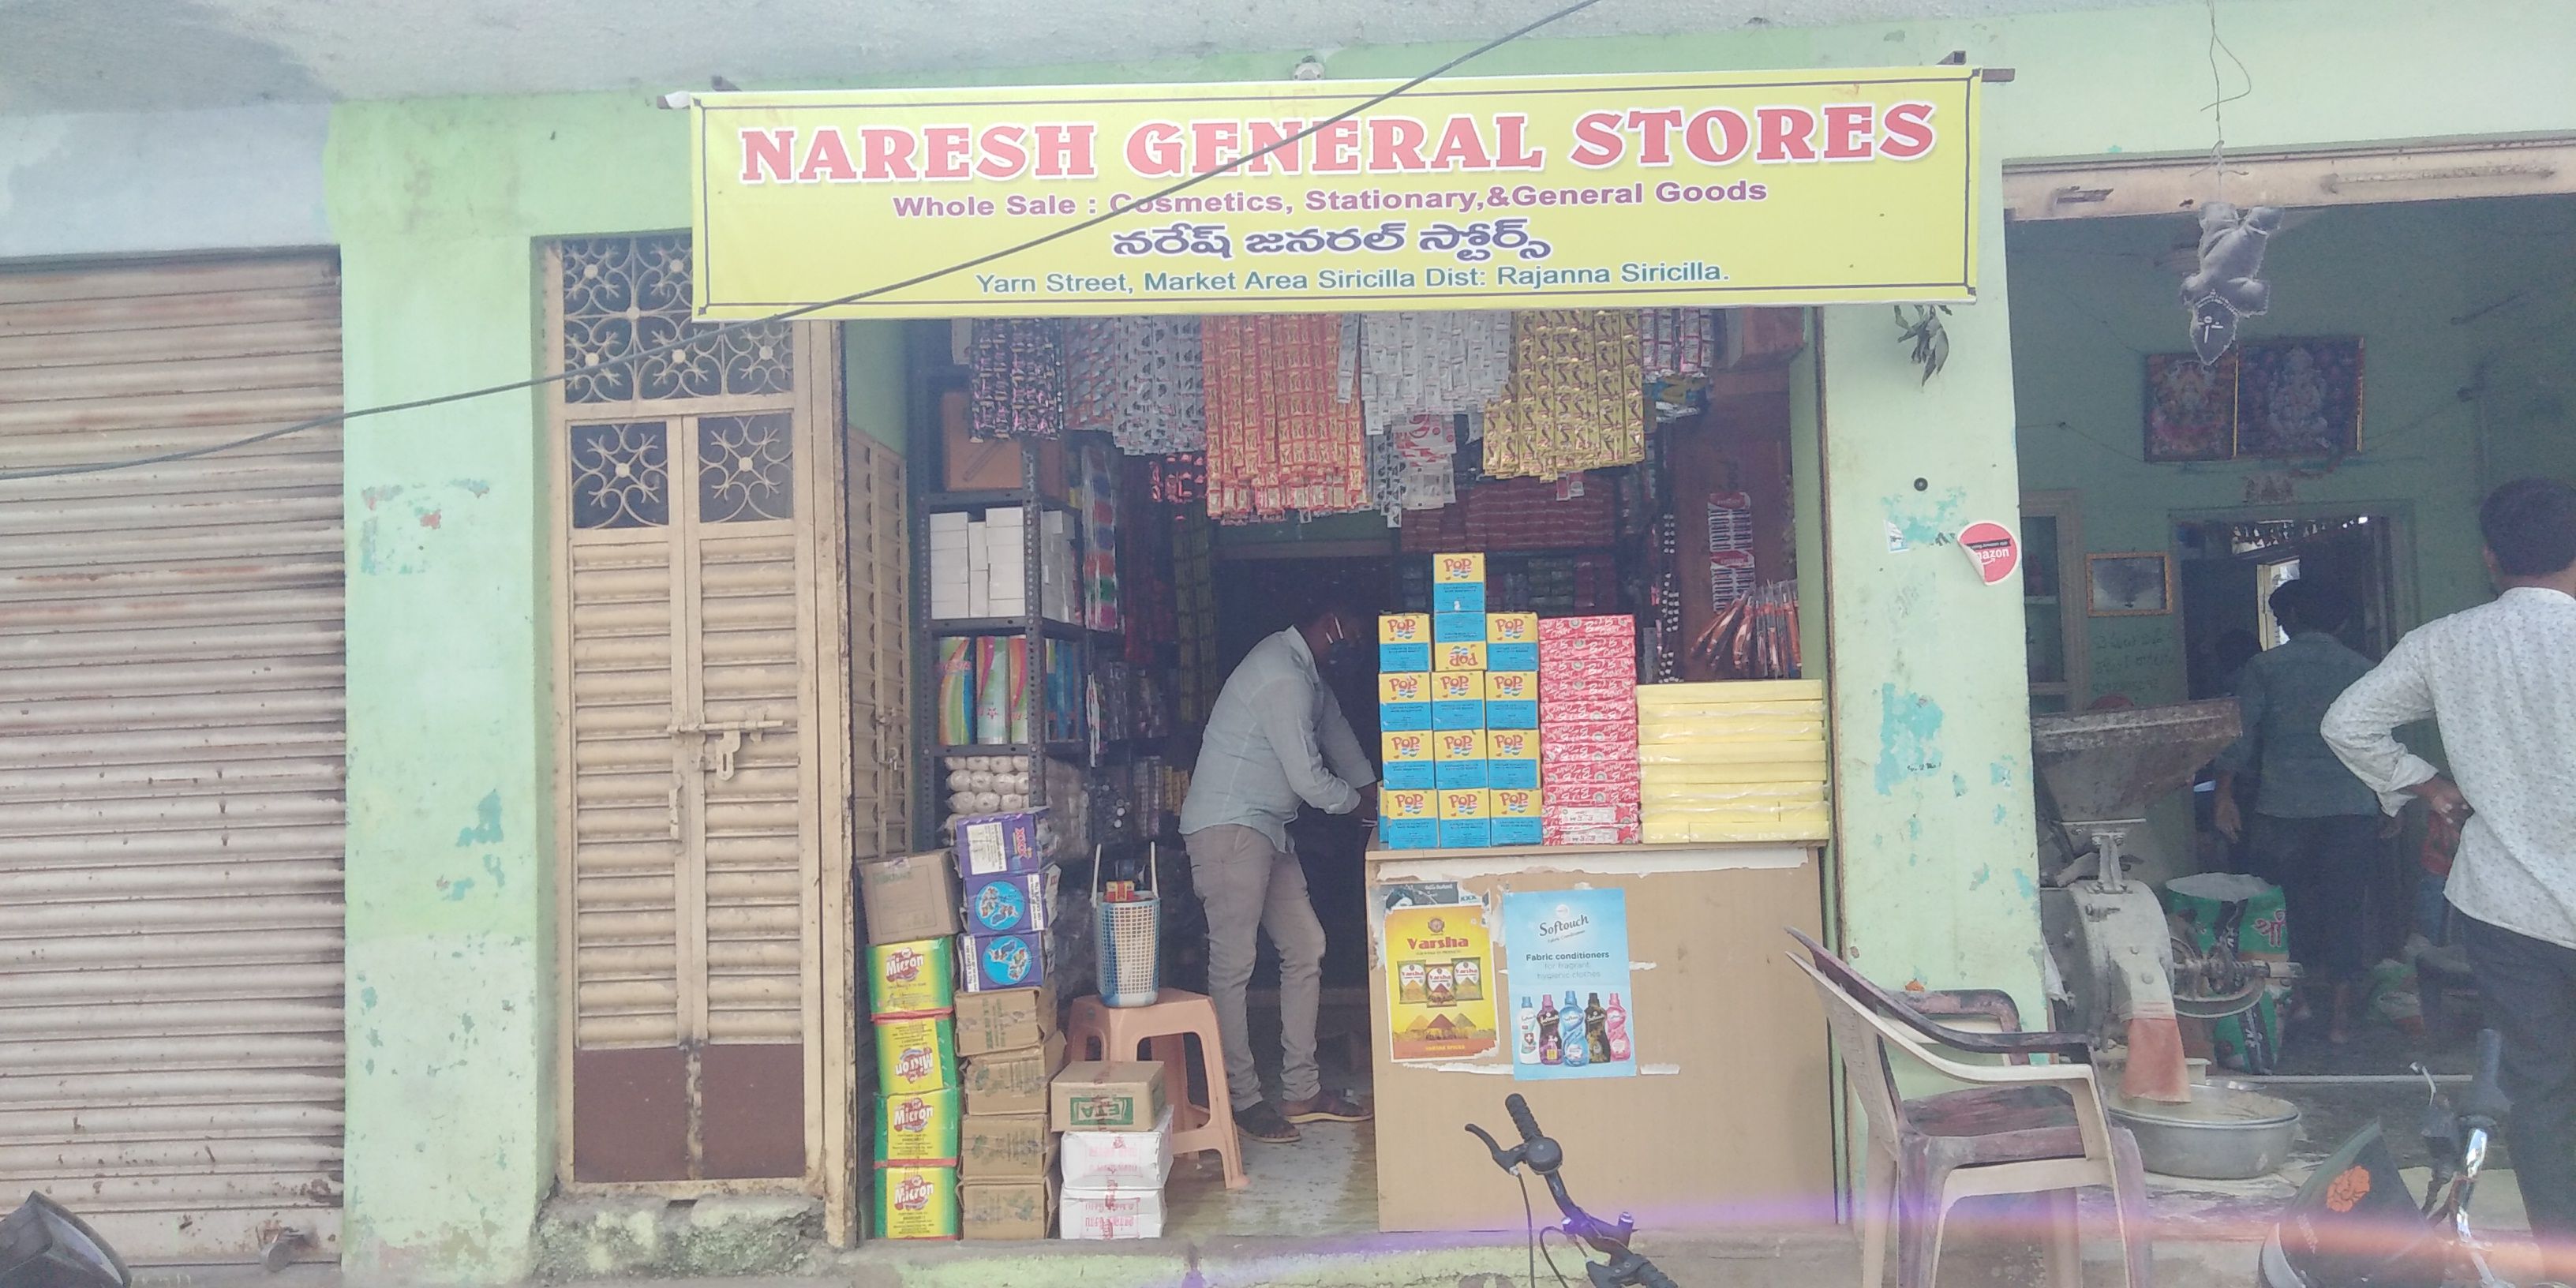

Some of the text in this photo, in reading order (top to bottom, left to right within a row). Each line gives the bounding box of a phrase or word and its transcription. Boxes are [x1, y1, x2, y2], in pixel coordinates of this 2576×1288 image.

[740, 103, 1936, 182] NARESH GENERAL STORES
[893, 196, 994, 218] Whole
[1005, 195, 1076, 215] Sale
[1110, 192, 1294, 215] Cosmetics,
[1305, 182, 1643, 214] Stationary,&General
[1655, 180, 1768, 203] Goods
[1113, 216, 1552, 261] నరేష్ జనరల్ స్టోర్స్
[975, 260, 1731, 295] Yarn Street, Market Area Siricilla Dist: Rajanna Siricilla.
[1978, 548, 2010, 560] azon
[1539, 914, 1589, 937] Softouch
[1406, 936, 1470, 950] Varsha
[1526, 951, 1610, 961] Fabric conditioners
